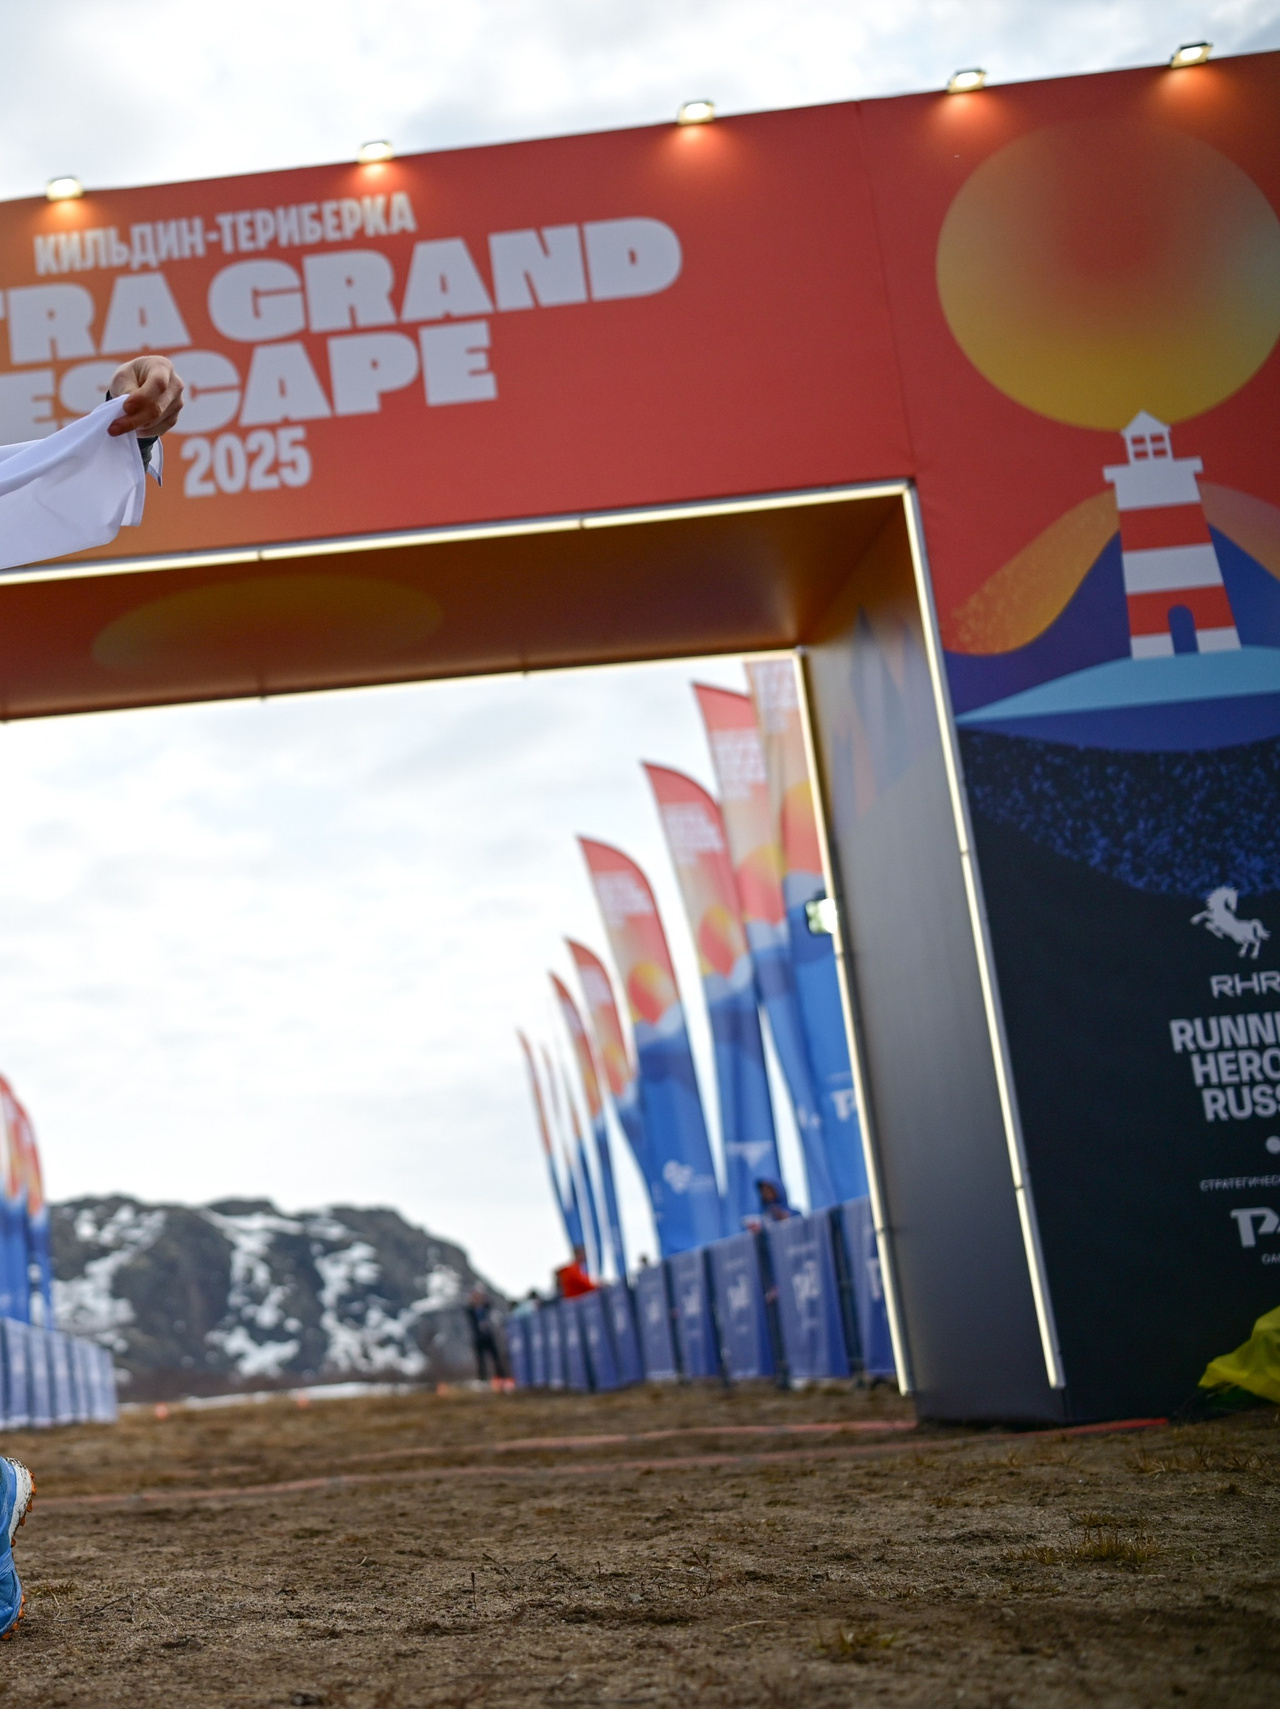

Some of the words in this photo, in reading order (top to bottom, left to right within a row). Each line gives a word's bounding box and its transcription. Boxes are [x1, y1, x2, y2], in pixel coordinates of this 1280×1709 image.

[33, 191, 417, 275] КИЛЬДИН-ТЕРИБЕРКА
[208, 217, 682, 342] GRAND
[180, 426, 312, 498] 2025
[1201, 1083, 1280, 1122] RUS
